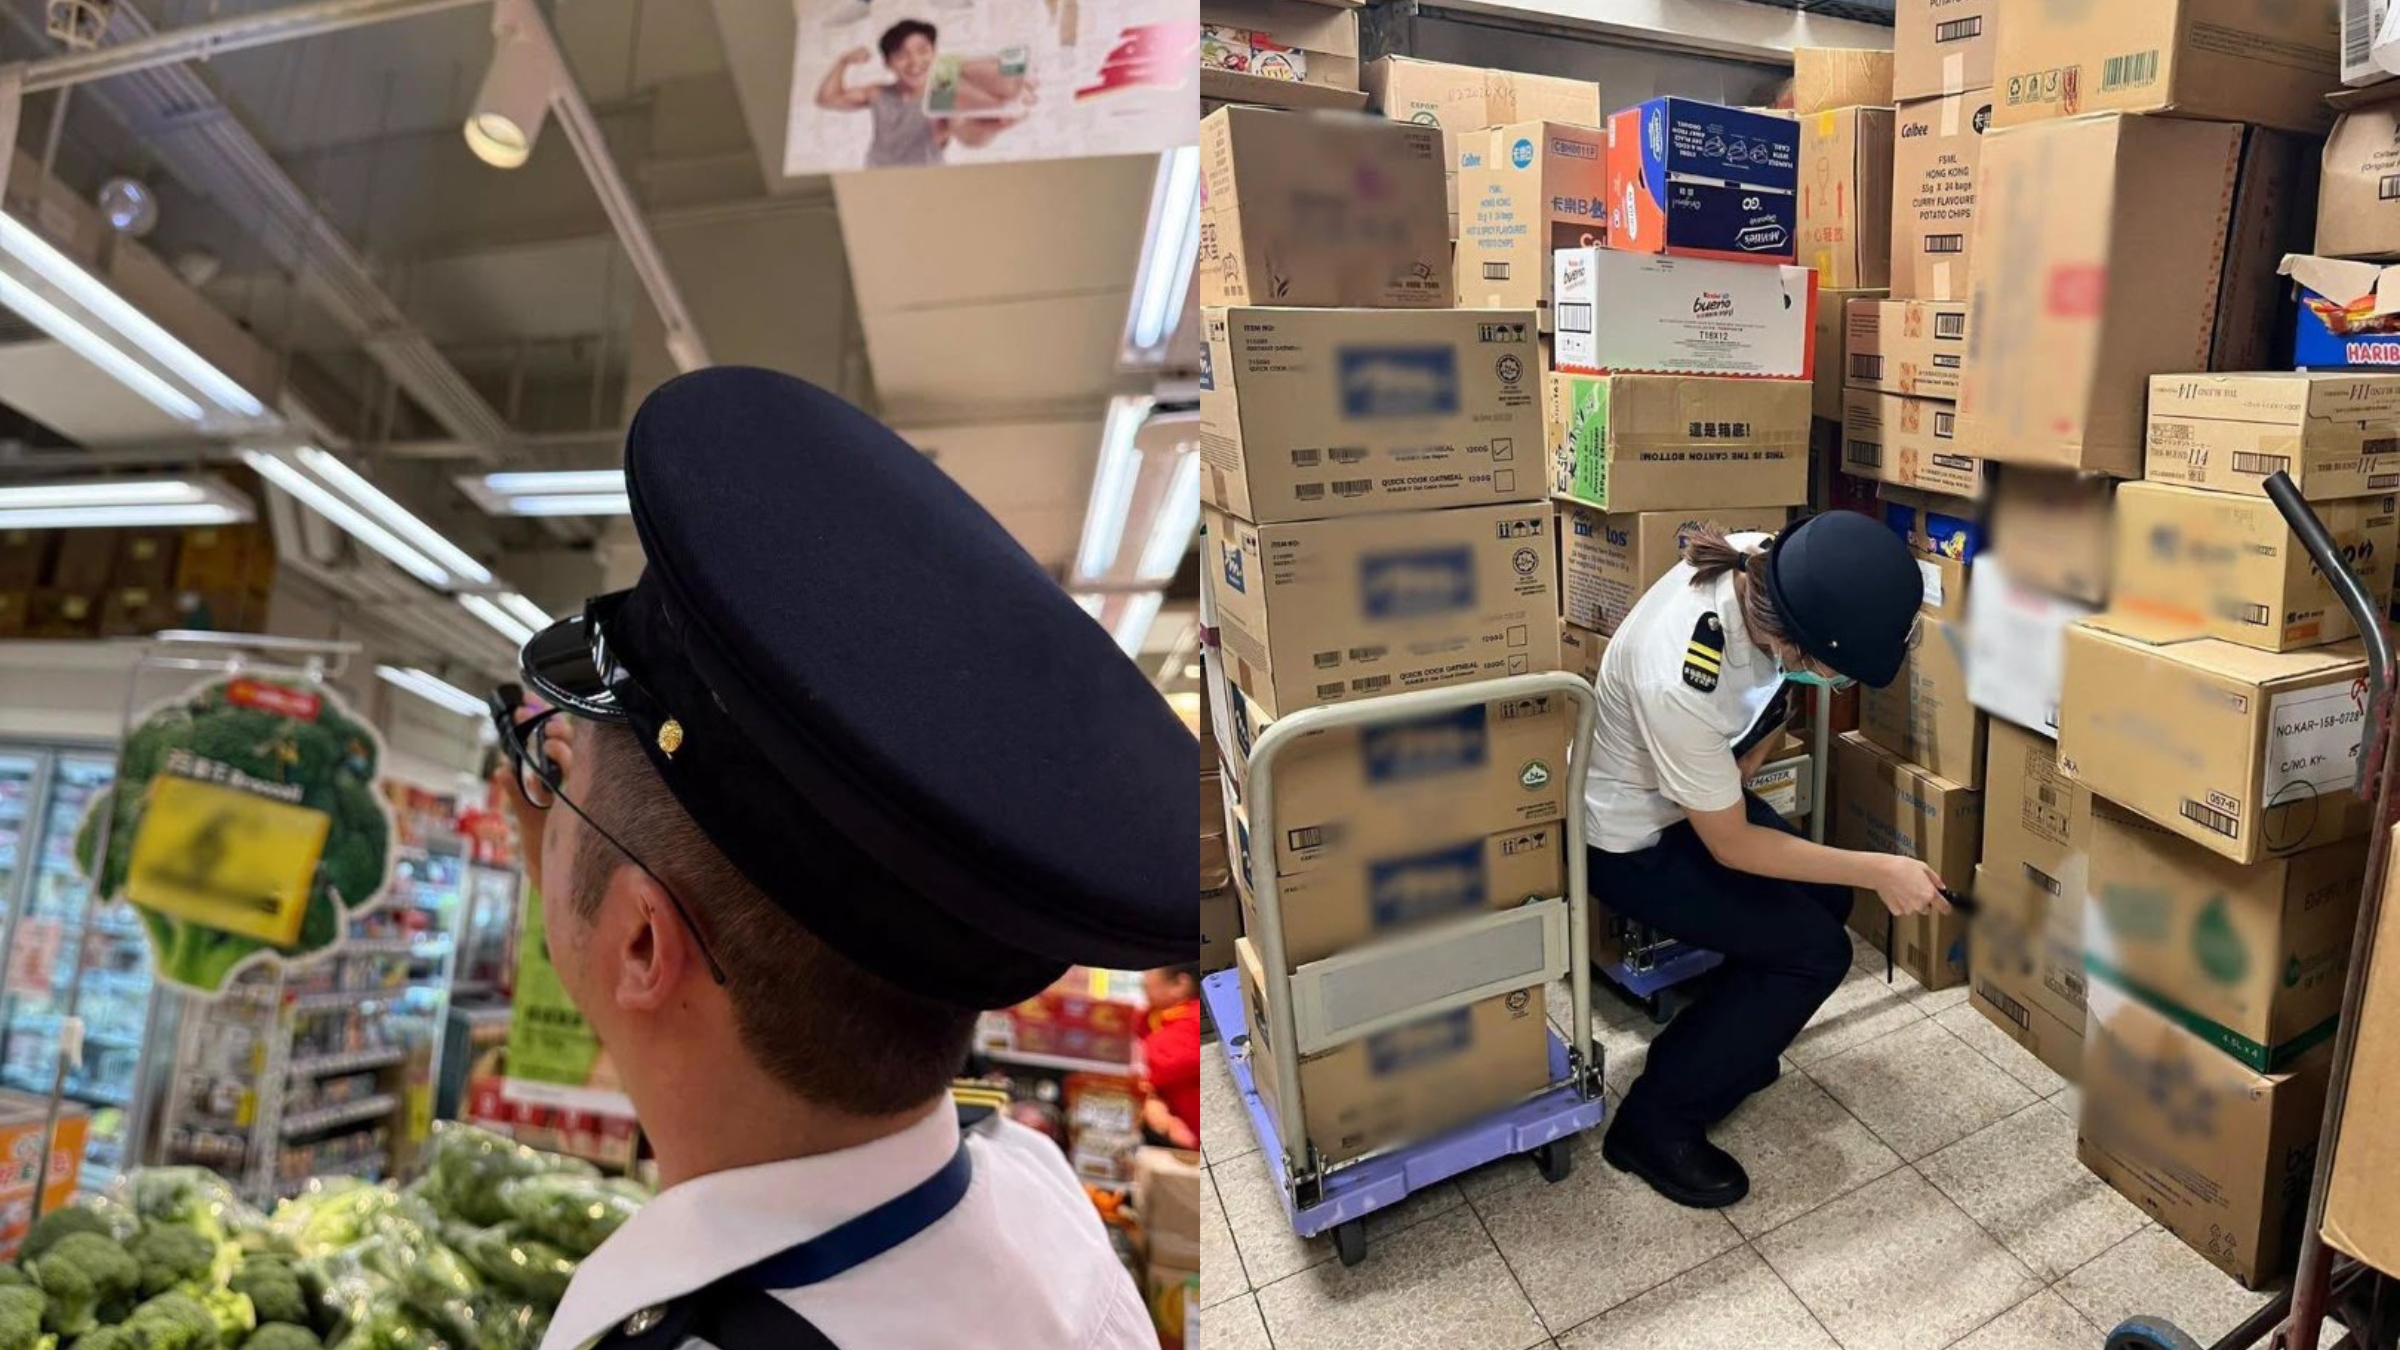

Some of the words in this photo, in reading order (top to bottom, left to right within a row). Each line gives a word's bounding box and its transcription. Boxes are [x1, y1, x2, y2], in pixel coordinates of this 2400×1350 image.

[1410, 101, 1439, 110] EXPORT
[1901, 123, 1928, 138] Calbee
[1938, 155, 1957, 165] FSML
[1925, 168, 1946, 178] HONG
[1947, 166, 1969, 177] KONG
[1955, 181, 1972, 192] bags
[1742, 197, 1760, 211] GO
[1912, 198, 1936, 208] CURRY
[1937, 195, 1976, 206] FLAVOURE
[1919, 209, 1946, 220] POTATO
[1948, 208, 1971, 219] CHIPS
[1563, 266, 1586, 285] bueno
[1693, 297, 1732, 314] bueno
[1688, 422, 1751, 438] 這是箱底!
[1689, 452, 1728, 461] CARTON
[1732, 452, 1749, 461] THE
[1753, 452, 1762, 460] IS
[1765, 451, 1785, 460] THIS
[2209, 792, 2236, 811] 057-R
